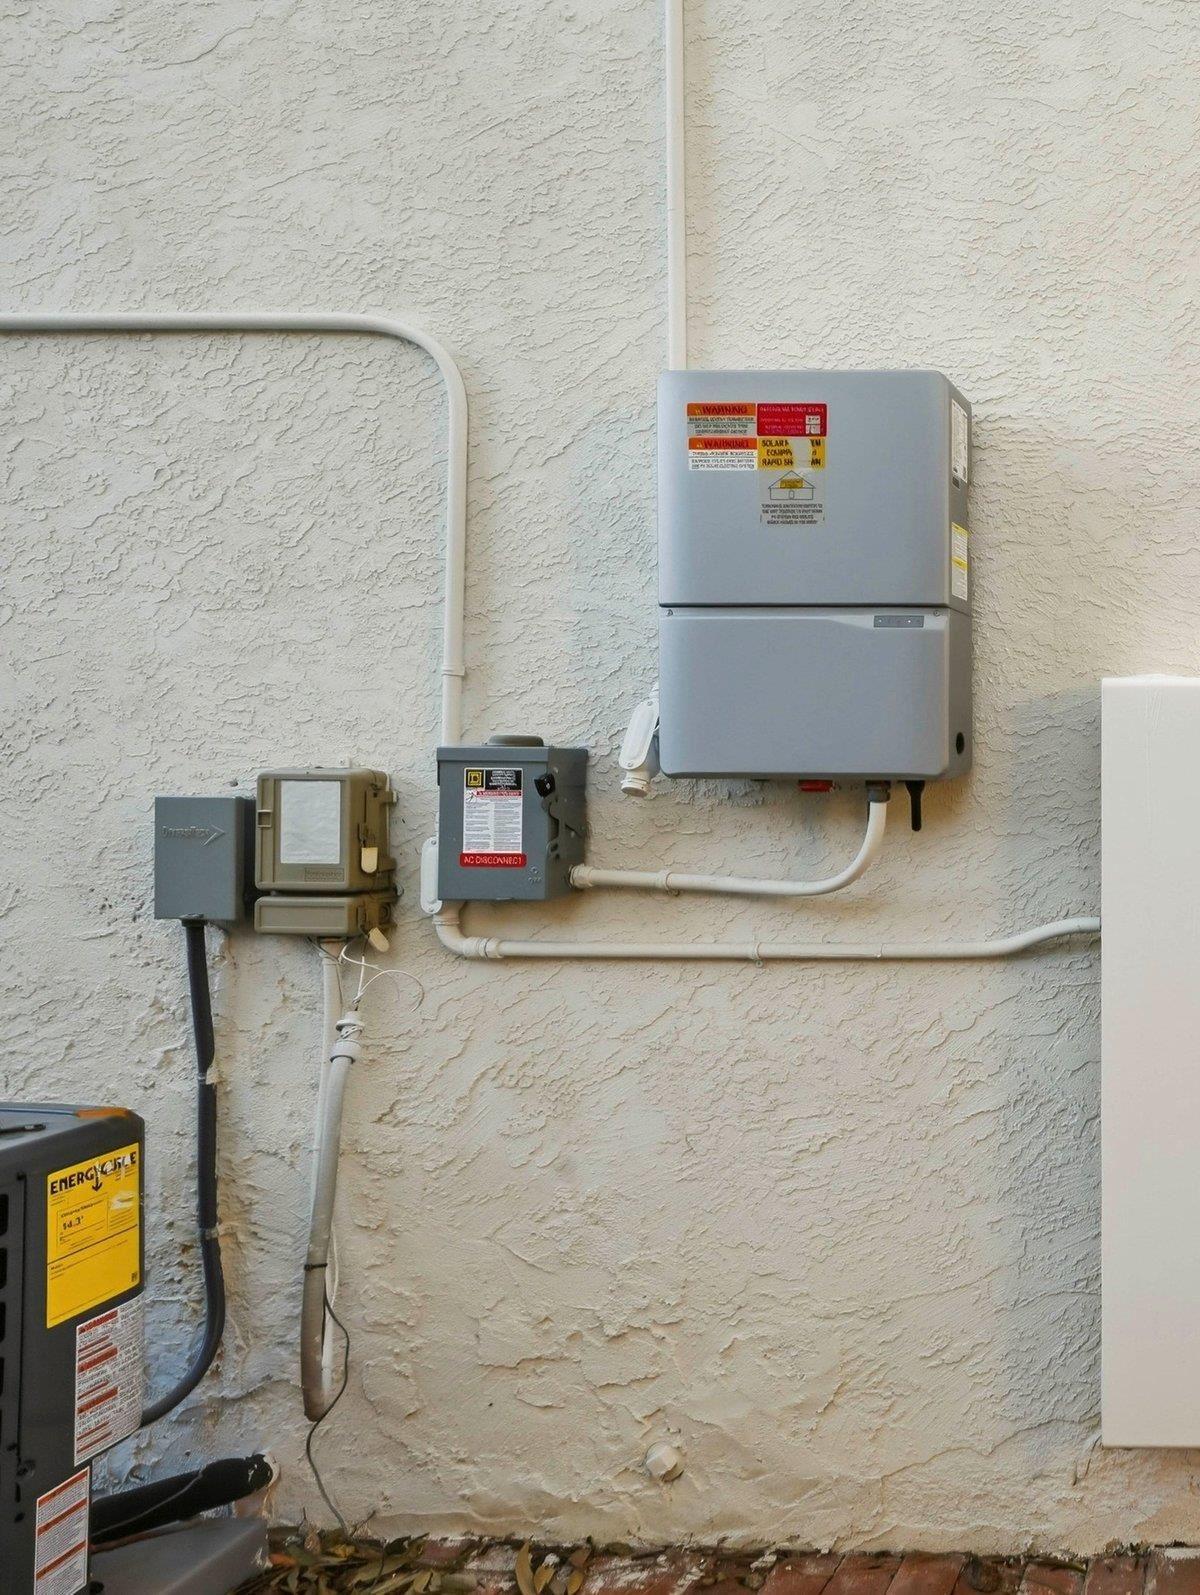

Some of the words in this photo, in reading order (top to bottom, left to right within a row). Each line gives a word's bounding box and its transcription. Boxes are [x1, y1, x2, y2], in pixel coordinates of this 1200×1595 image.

[702, 405, 748, 415] WARNING
[704, 439, 749, 450] WARNING
[464, 856, 475, 864] AC
[475, 856, 522, 865] DISCONNECT
